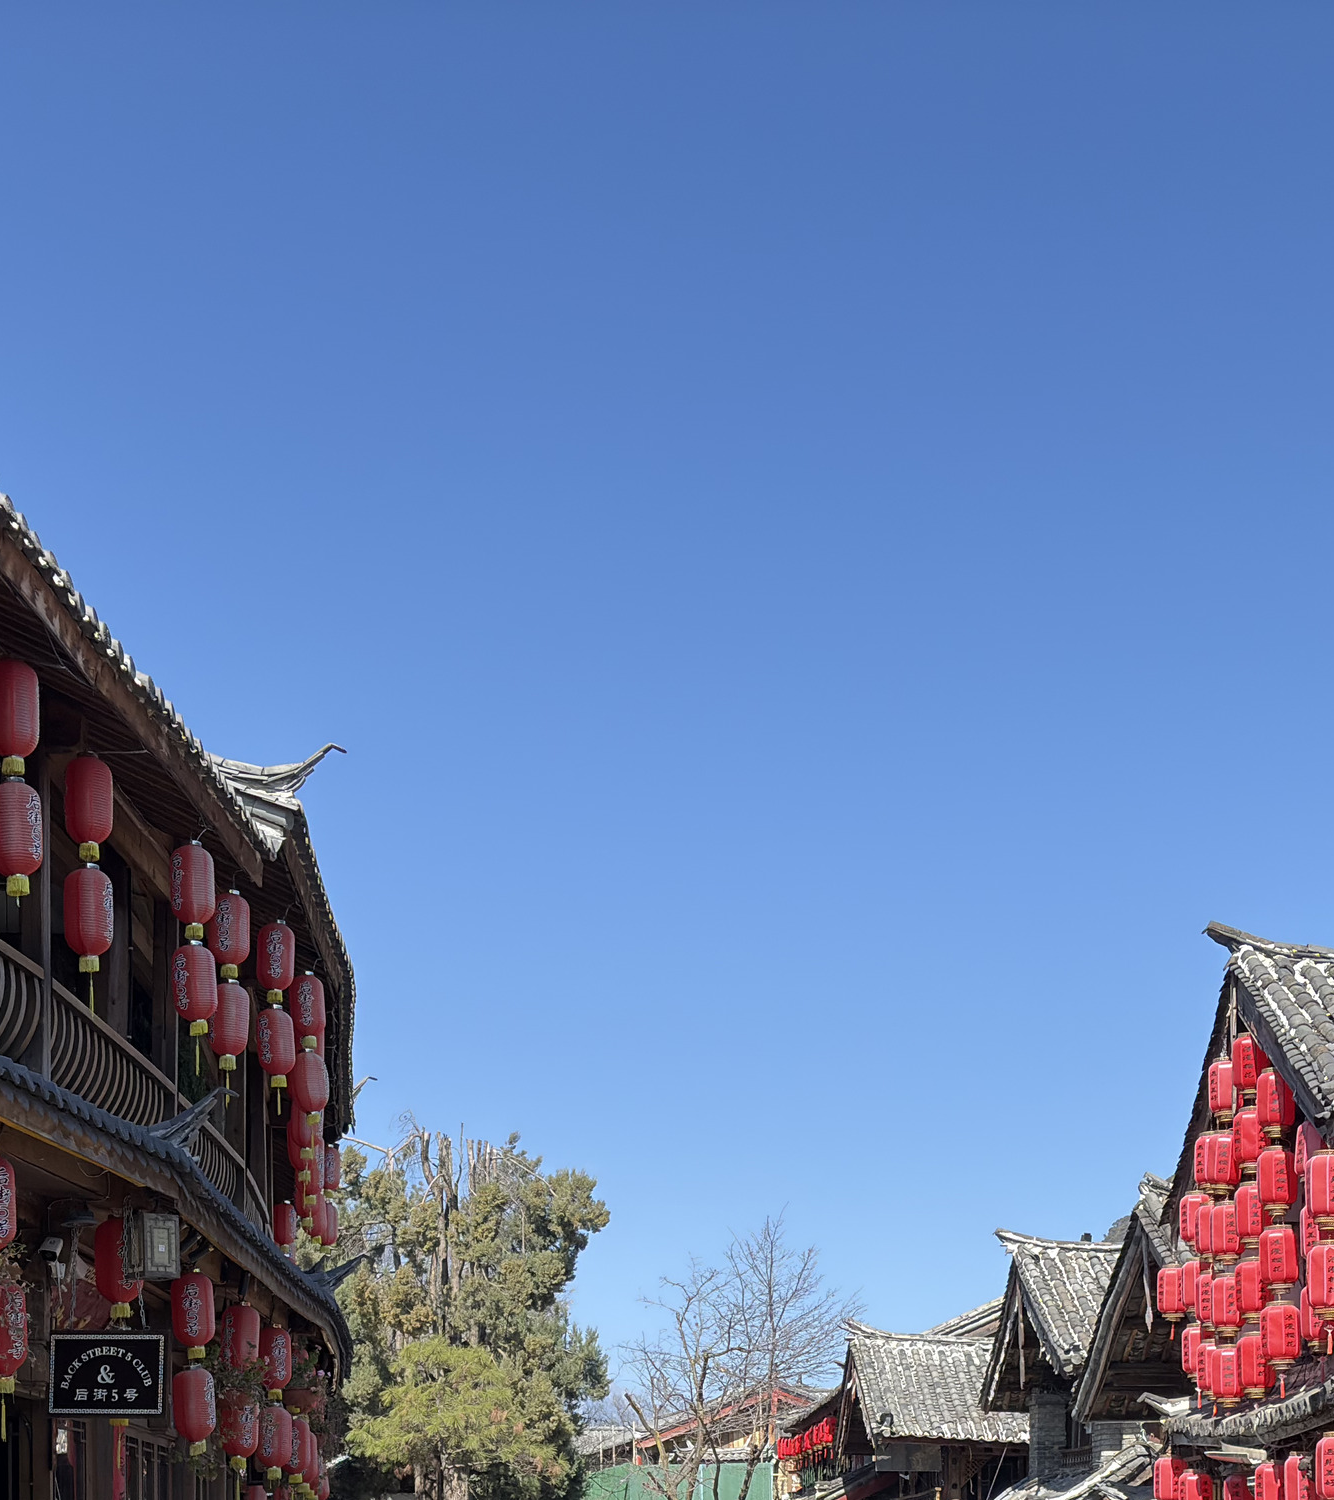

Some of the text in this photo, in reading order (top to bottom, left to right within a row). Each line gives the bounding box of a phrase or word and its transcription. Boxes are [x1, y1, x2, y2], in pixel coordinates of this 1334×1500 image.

[60, 1346, 153, 1390] BACK STREET 5 CLUB
[97, 1364, 115, 1384] &
[74, 1388, 139, 1402] 后街5号
